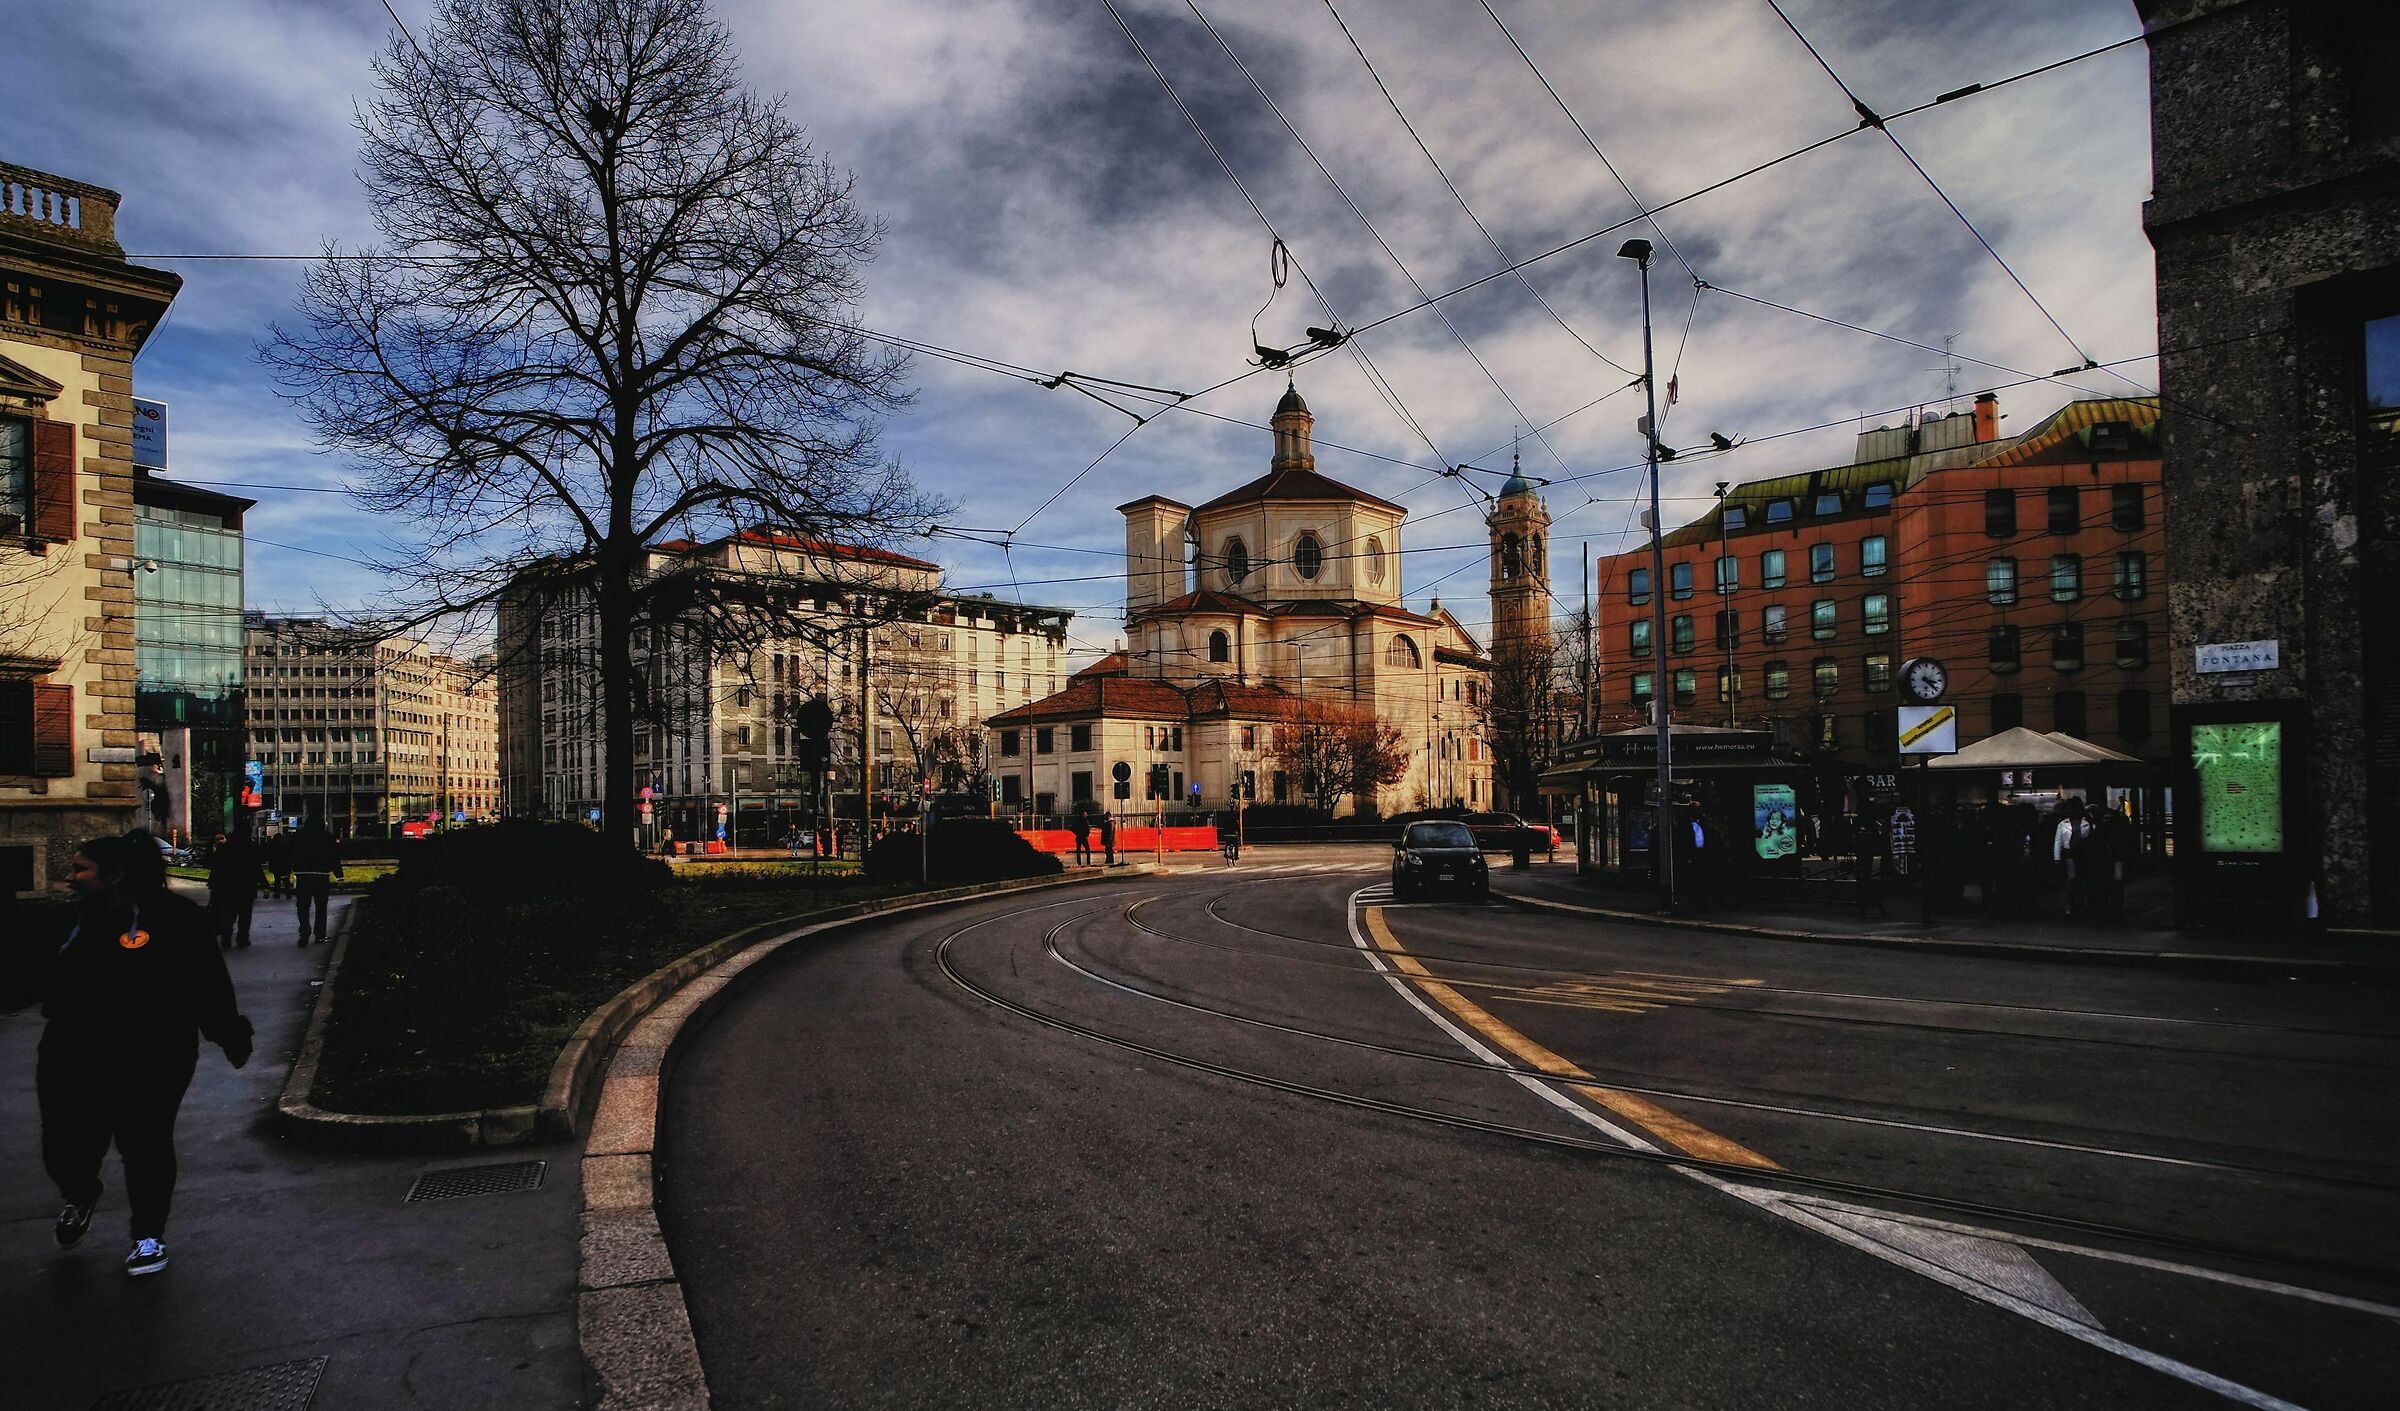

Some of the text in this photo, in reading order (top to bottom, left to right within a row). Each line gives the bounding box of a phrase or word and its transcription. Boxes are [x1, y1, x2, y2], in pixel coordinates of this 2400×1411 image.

[2221, 643, 2250, 651] PIAZZA
[2202, 653, 2272, 666] FONTANA
[1866, 774, 1896, 787] BAR
